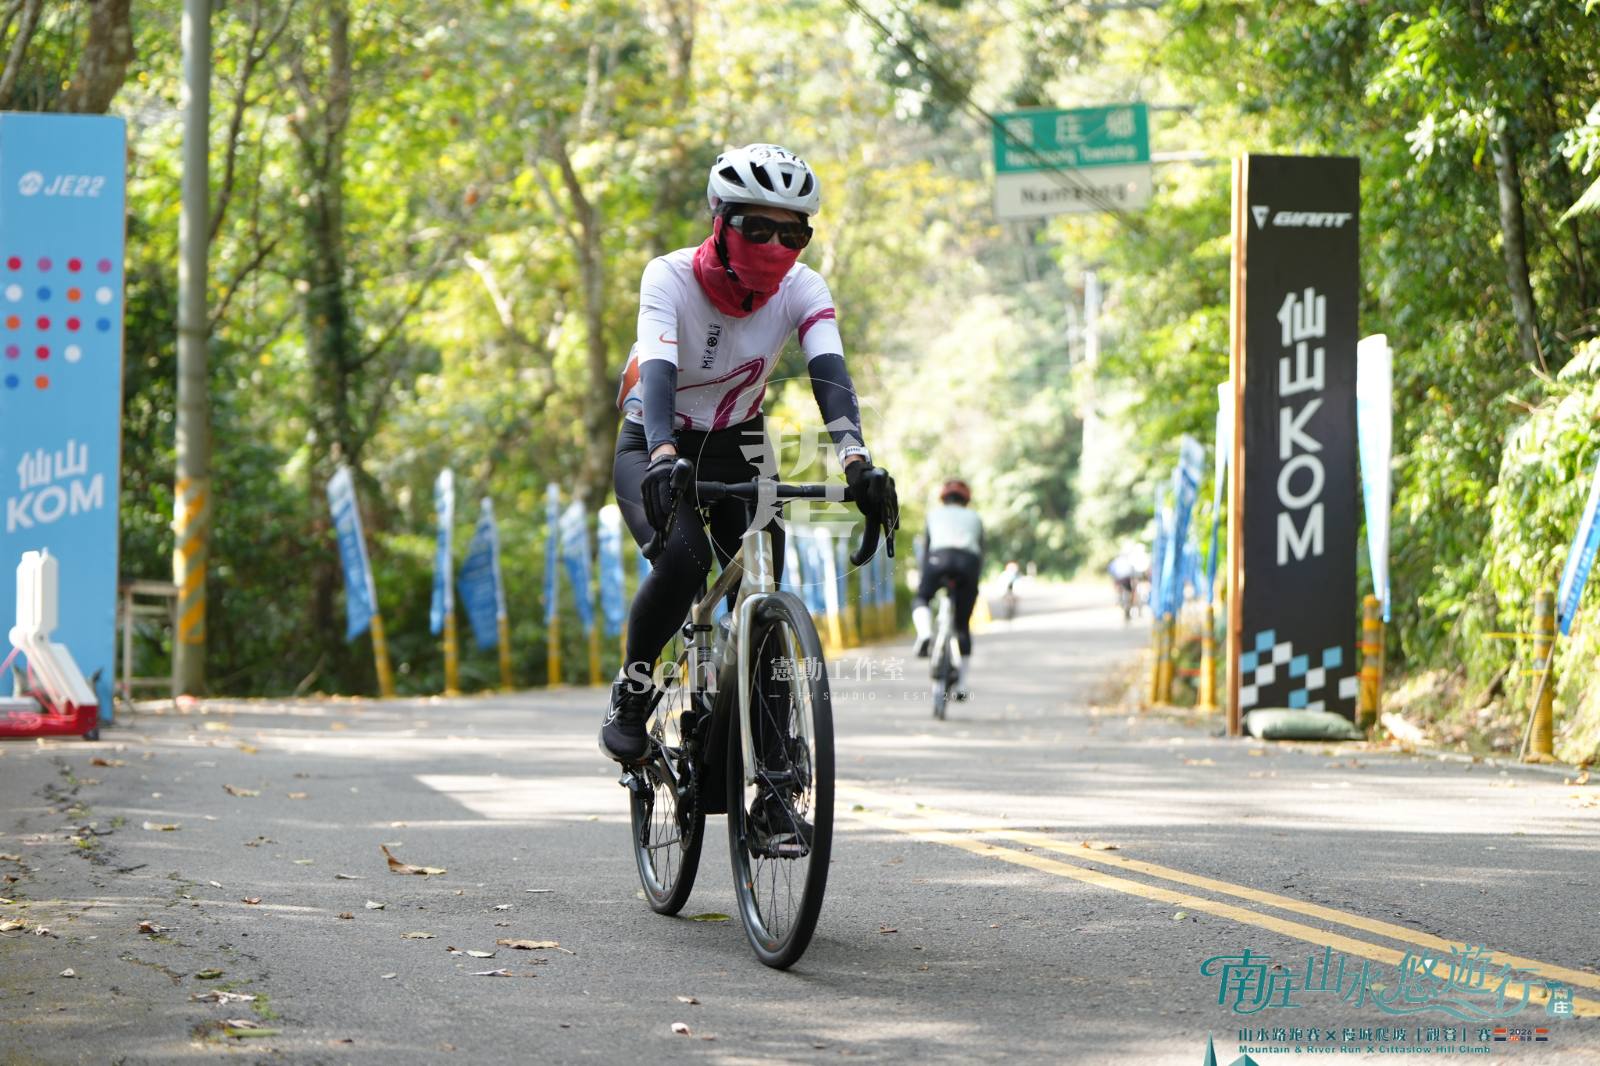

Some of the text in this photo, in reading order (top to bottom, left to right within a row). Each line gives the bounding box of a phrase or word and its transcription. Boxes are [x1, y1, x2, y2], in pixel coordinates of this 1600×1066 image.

[44, 175, 106, 198] JE22
[1272, 211, 1353, 228] GIANT
[1277, 286, 1327, 566] 仙山 KOM
[17, 439, 88, 491] 仙山
[5, 472, 105, 532] KOM
